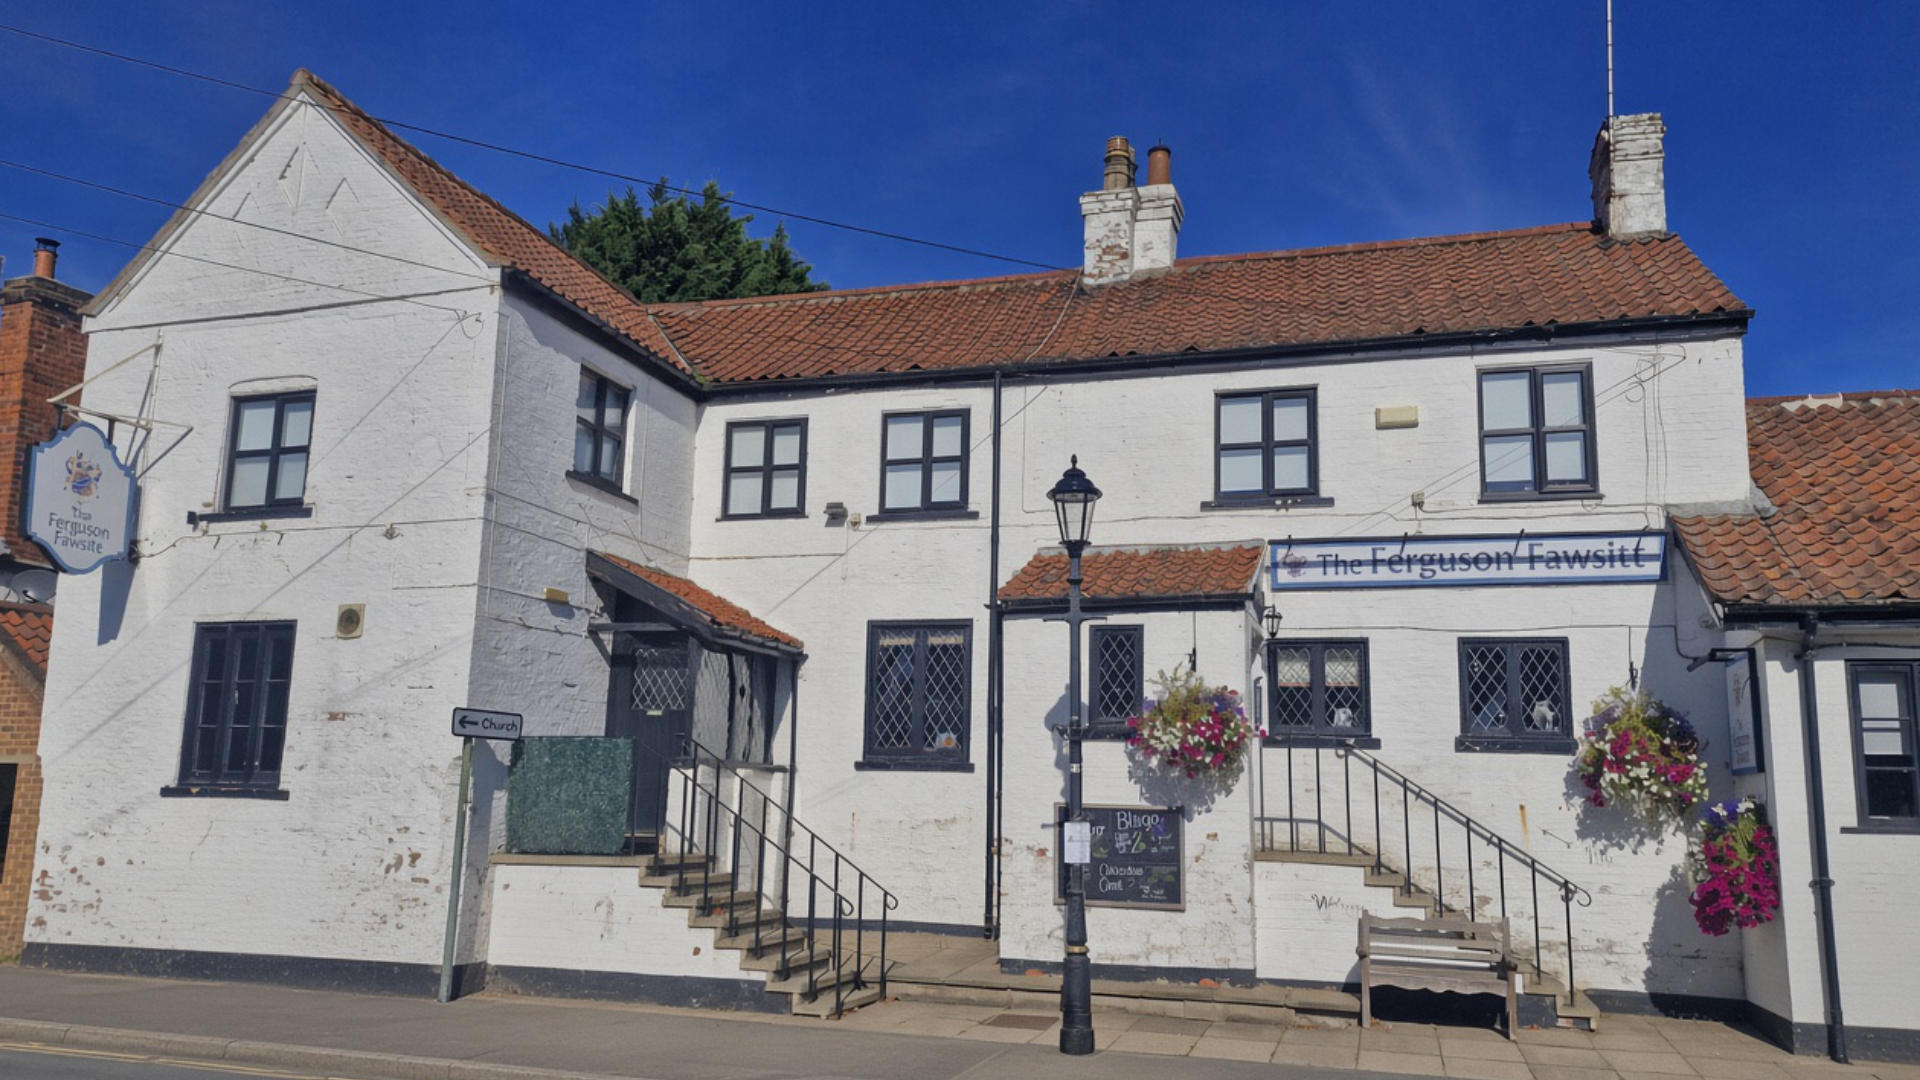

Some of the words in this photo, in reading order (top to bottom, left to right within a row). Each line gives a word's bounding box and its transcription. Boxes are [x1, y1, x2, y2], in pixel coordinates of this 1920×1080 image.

[48, 512, 110, 540] Ferguson
[1317, 553, 1363, 576] The
[1371, 546, 1514, 580] Ferguson
[1527, 541, 1646, 571] Fawsitt
[481, 717, 518, 732] Church
